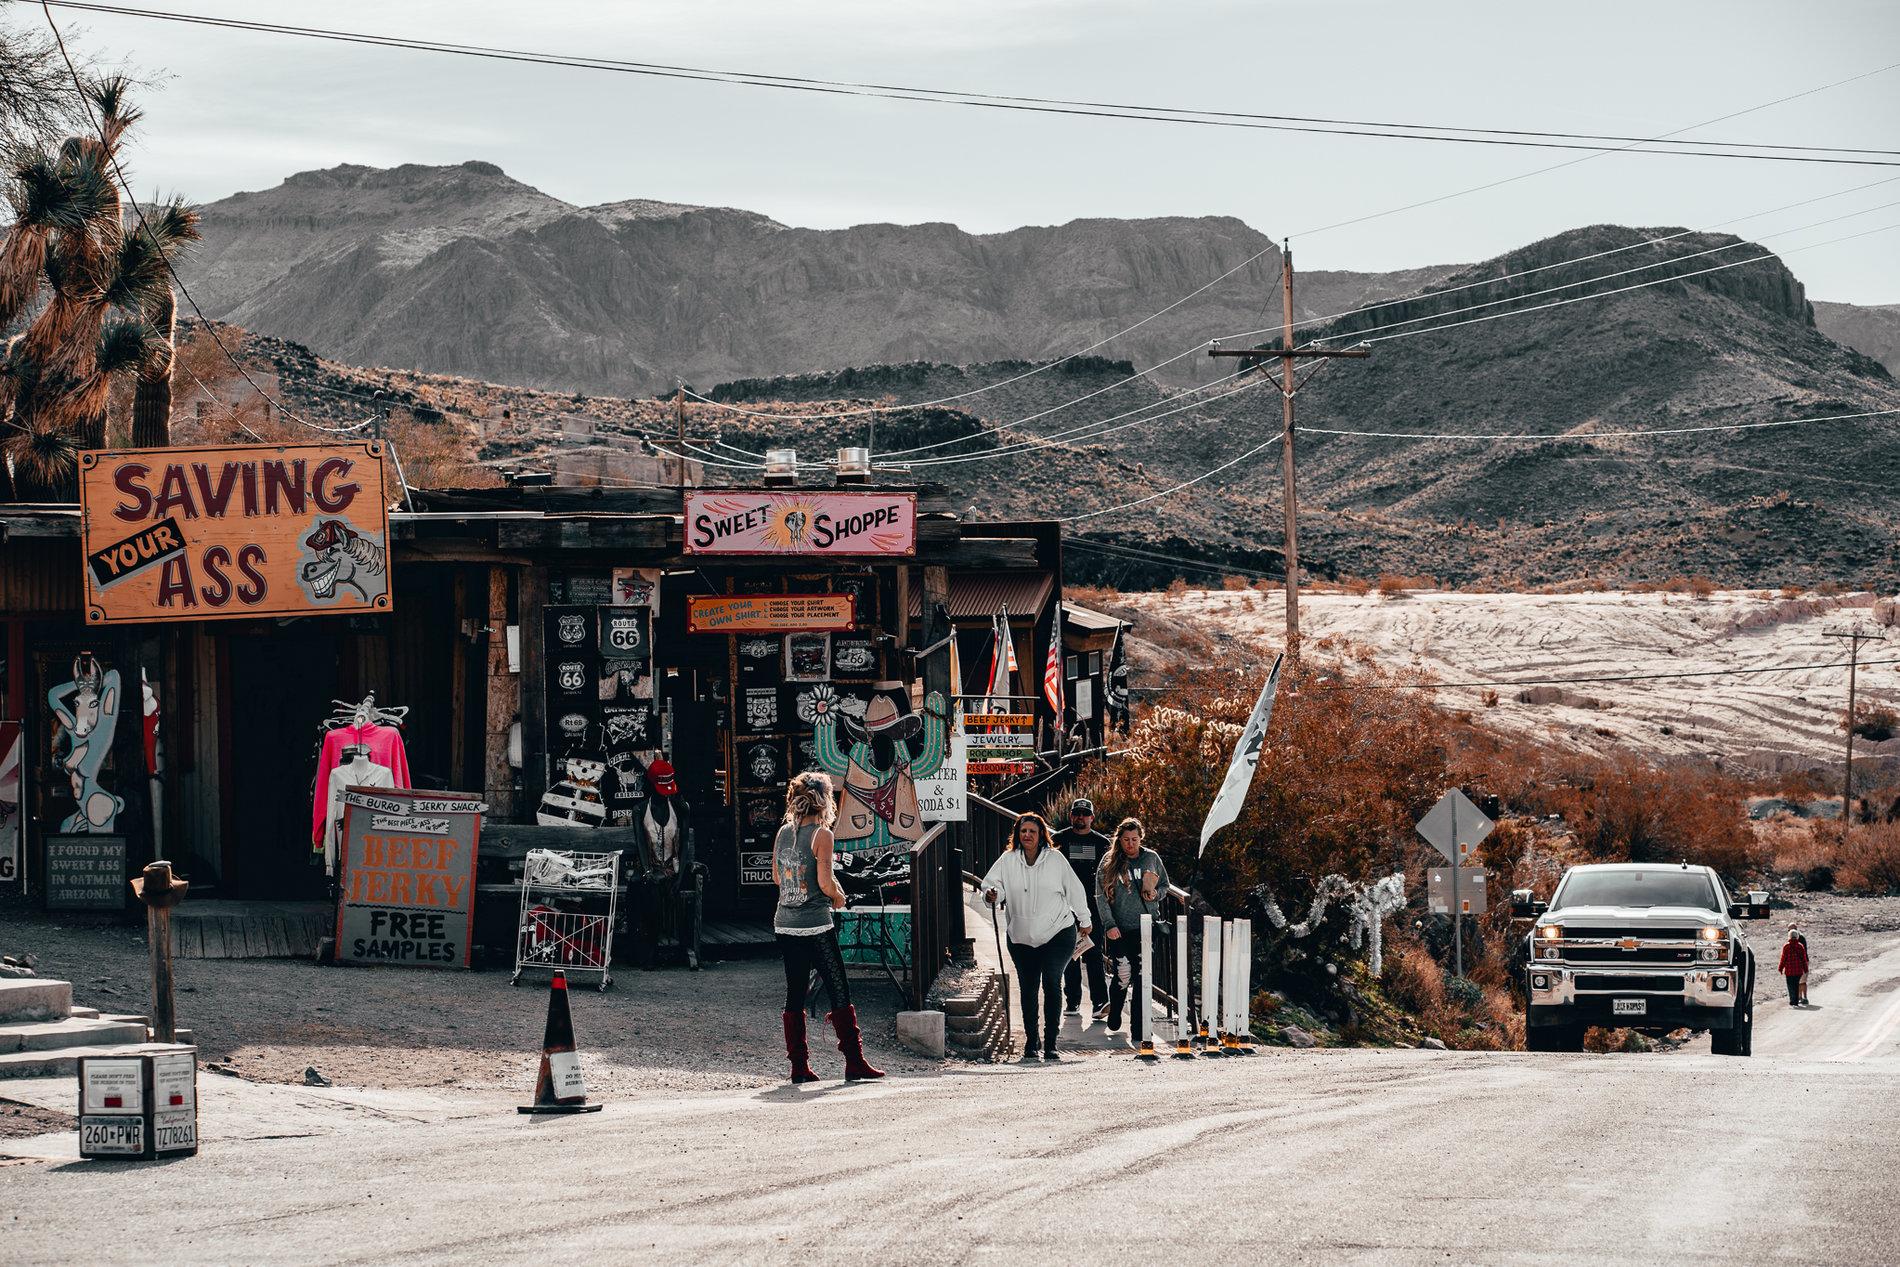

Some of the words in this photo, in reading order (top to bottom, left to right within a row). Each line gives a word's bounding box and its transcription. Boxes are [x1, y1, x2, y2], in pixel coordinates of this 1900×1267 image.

[112, 457, 362, 522] SAVING
[694, 504, 771, 547] SWEET
[812, 505, 900, 548] SHOPPE
[99, 525, 179, 576] YOUR
[156, 544, 269, 609] ASS
[693, 605, 725, 619] CREATE
[728, 600, 752, 611] YOUR
[709, 615, 733, 627] OWN
[735, 609, 761, 621] SHIRT
[612, 631, 638, 646] 66
[850, 654, 864, 664] 66
[562, 673, 582, 686] 66
[755, 704, 768, 714] 66
[967, 716, 990, 724] BEEF
[993, 715, 1020, 724] JERKY
[970, 750, 993, 758] ROCK
[996, 749, 1022, 758] SHOP
[967, 763, 1011, 773] RESTROOMS
[933, 784, 944, 796] &
[344, 793, 362, 804] THE
[366, 798, 401, 813] BURRO
[419, 802, 448, 812] JERKY
[451, 802, 480, 812] SHACK
[918, 798, 945, 811] SODA
[946, 797, 960, 810] $1
[387, 819, 399, 827] BEST
[400, 818, 415, 827] PIECE
[48, 845, 56, 856] I
[57, 845, 100, 856] FOUND
[102, 845, 122, 856] MY
[363, 835, 460, 870] BEEF
[51, 859, 95, 871] SWEET
[98, 860, 120, 871] ASS
[51, 874, 65, 885] IN
[744, 871, 771, 881] TRUC
[344, 870, 468, 908] JERKY
[370, 910, 446, 939] FREE
[353, 938, 456, 963] SAMPLES
[85, 1125, 108, 1144] 260
[117, 1125, 140, 1144] PWR
[157, 1125, 193, 1146] 7Z78261
